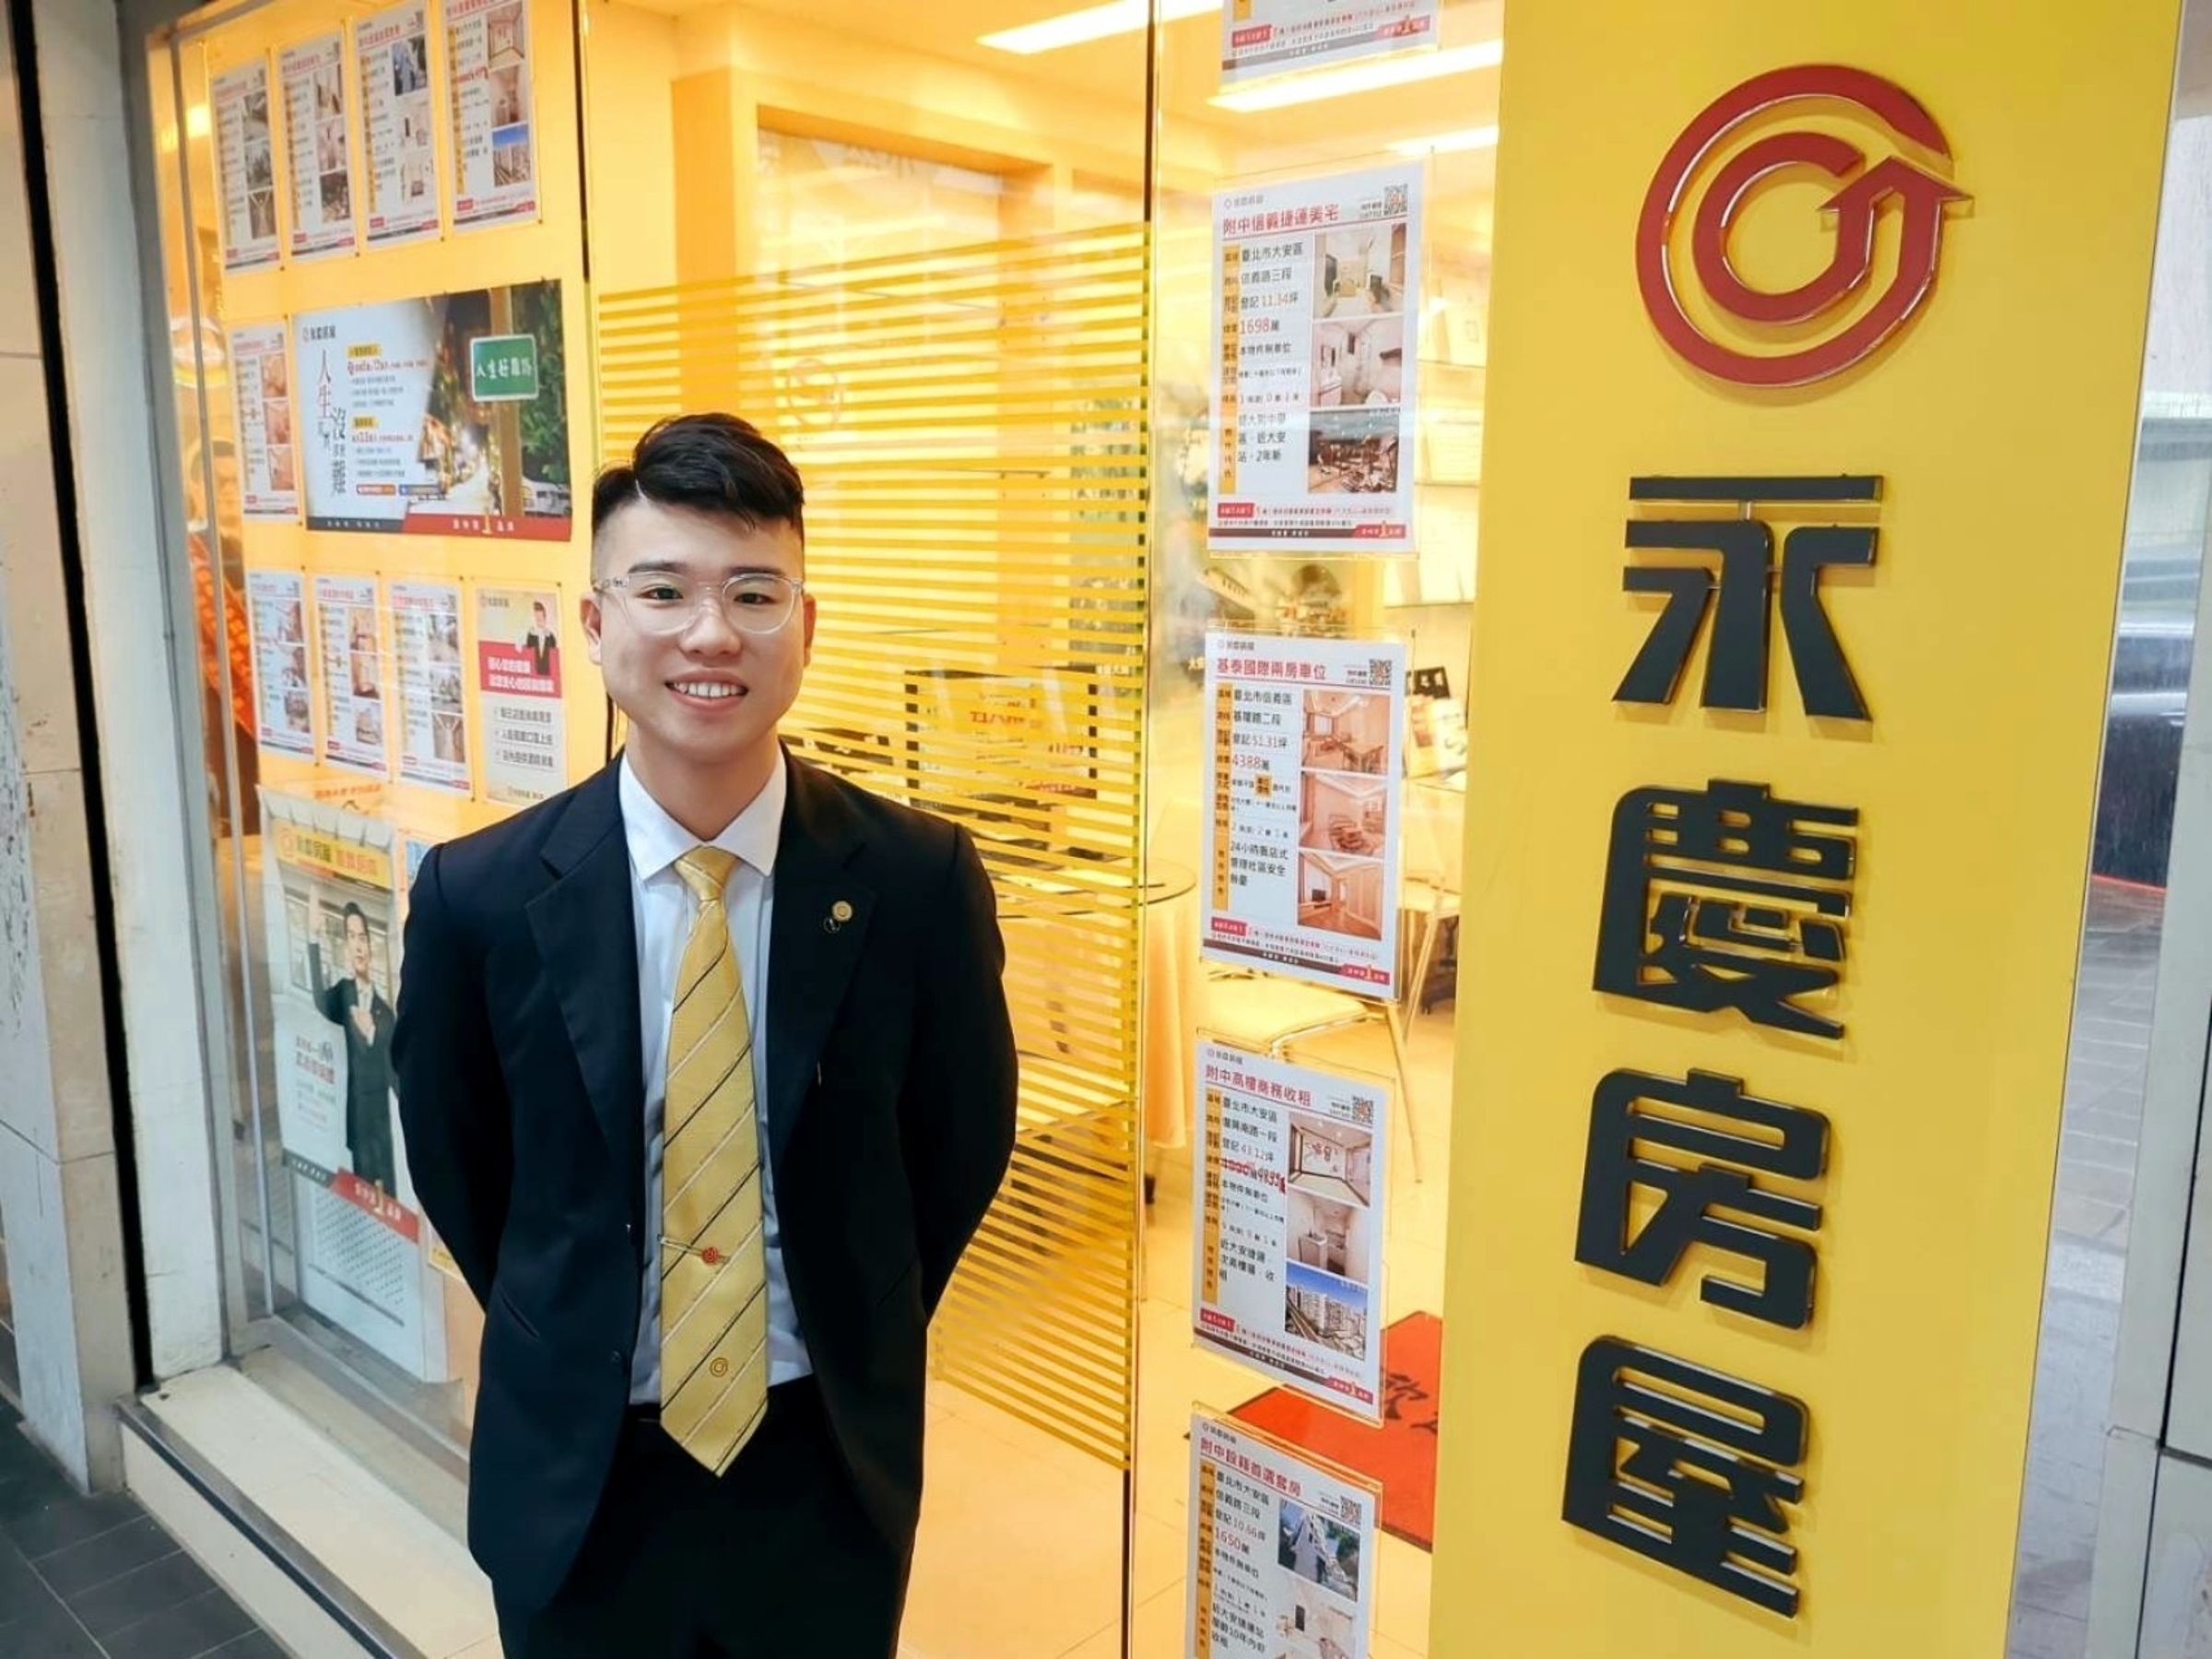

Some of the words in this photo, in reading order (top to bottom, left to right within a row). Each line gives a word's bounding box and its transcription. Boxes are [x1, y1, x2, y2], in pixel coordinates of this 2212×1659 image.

[1217, 658, 1326, 680] 基泰國際兩房車位
[1561, 474, 1883, 1619] 永慶房屋
